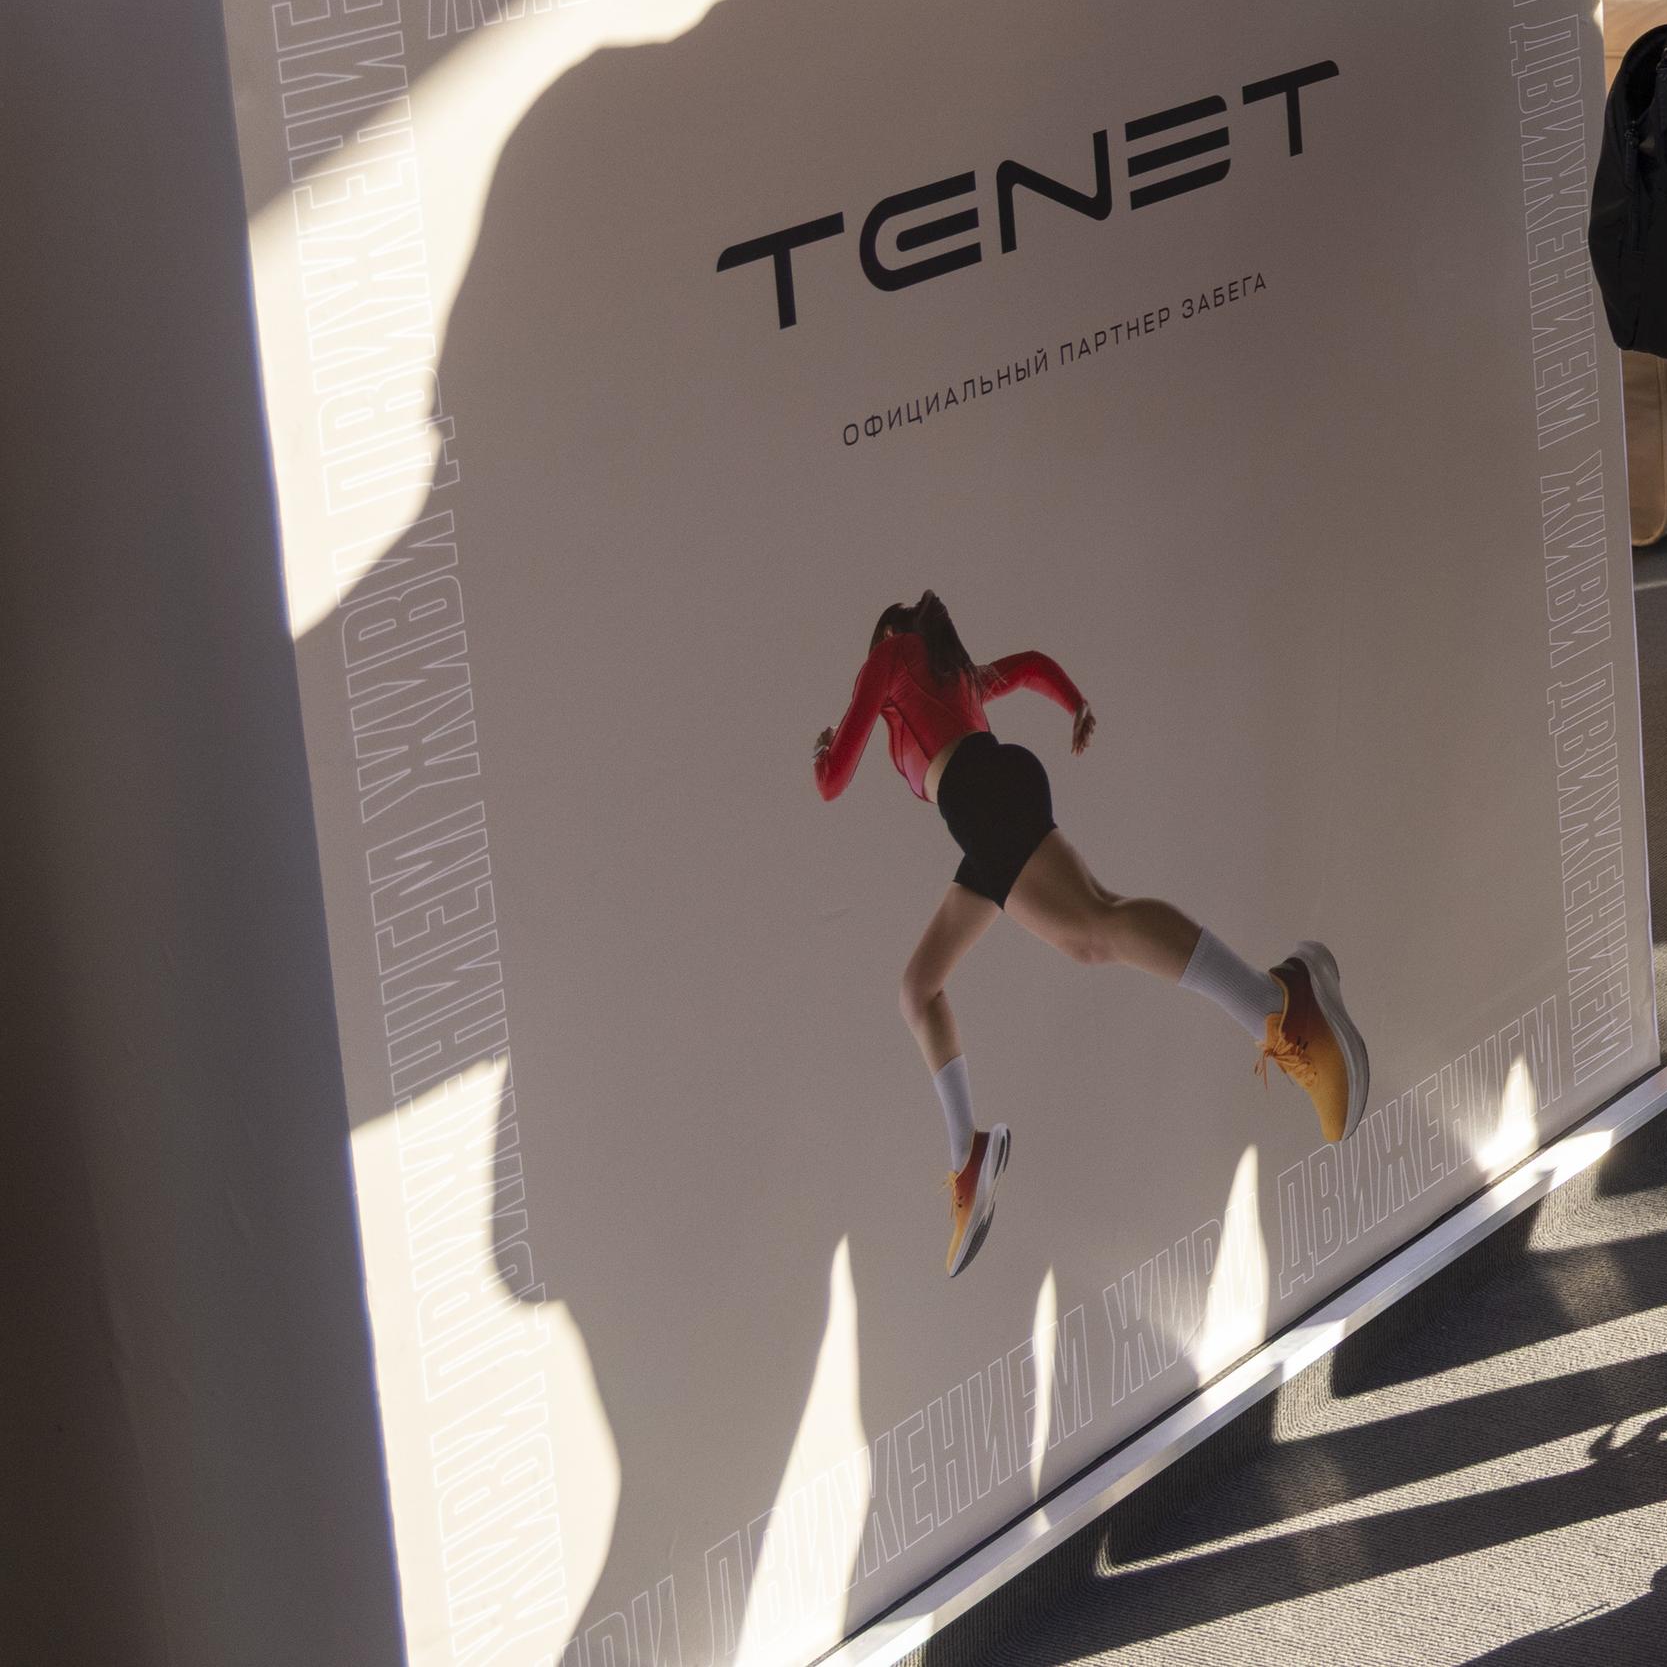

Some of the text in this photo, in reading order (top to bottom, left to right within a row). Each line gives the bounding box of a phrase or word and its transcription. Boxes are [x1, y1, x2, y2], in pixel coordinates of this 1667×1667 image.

[716, 59, 1341, 330] TENET
[842, 272, 1267, 446] ОФИЦИАЛЬНЫЙ ПАРТНЕР ЗАБЕГА
[1509, 15, 1601, 449] ДВИЖЕНИЕМ
[331, 509, 481, 823] ЖИВИ
[1540, 449, 1611, 668] ЖИВИ
[1547, 662, 1633, 1087] ДВИЖЕНИЕМ
[366, 801, 551, 1403] ДВИЖЕНИЕМ
[1103, 1191, 1265, 1407] ЖИВИ
[1277, 995, 1562, 1300] ДВИЖЕНИЕМ
